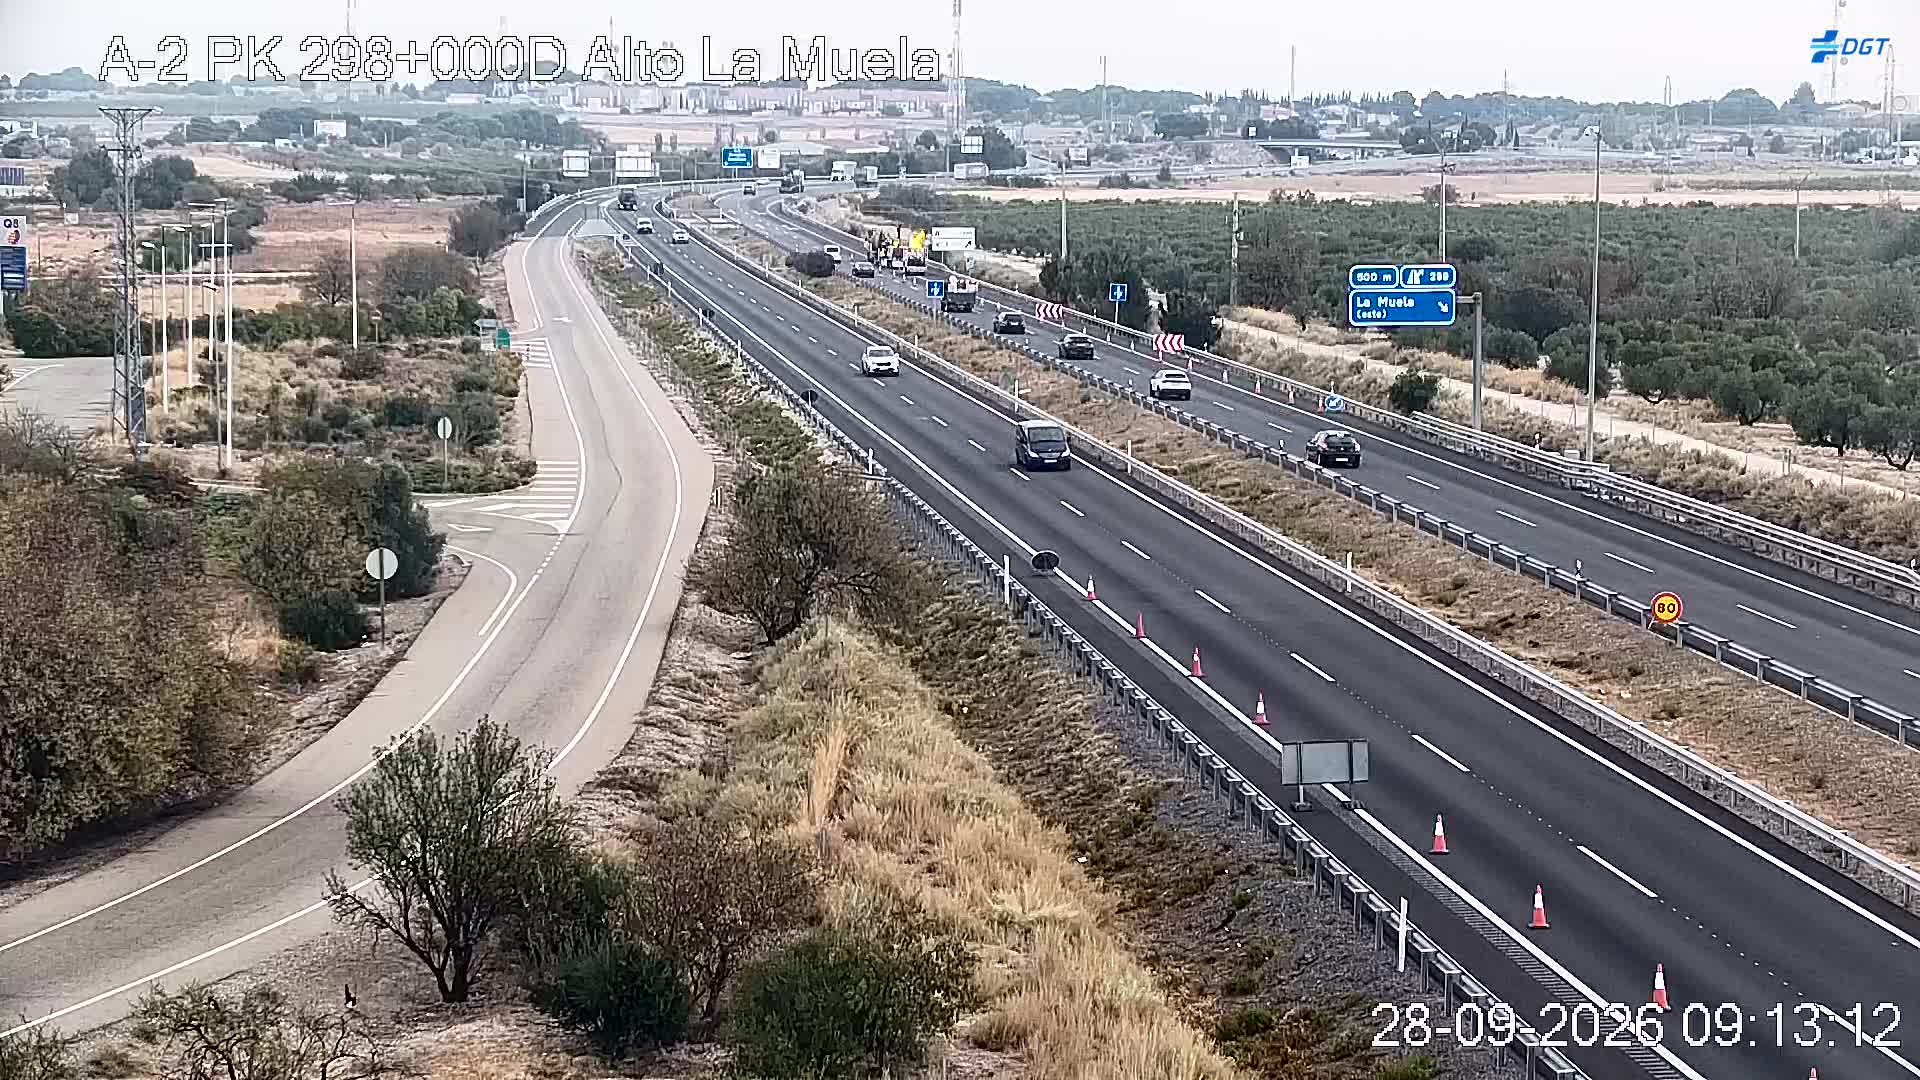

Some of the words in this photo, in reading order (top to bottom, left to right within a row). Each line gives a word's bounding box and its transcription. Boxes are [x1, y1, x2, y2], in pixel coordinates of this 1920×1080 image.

[3, 218, 19, 229] Q8
[1356, 271, 1378, 282] 500
[1382, 273, 1392, 282] m
[1356, 296, 1371, 308] La
[1377, 295, 1415, 308] Muela
[1657, 602, 1676, 614] 80
